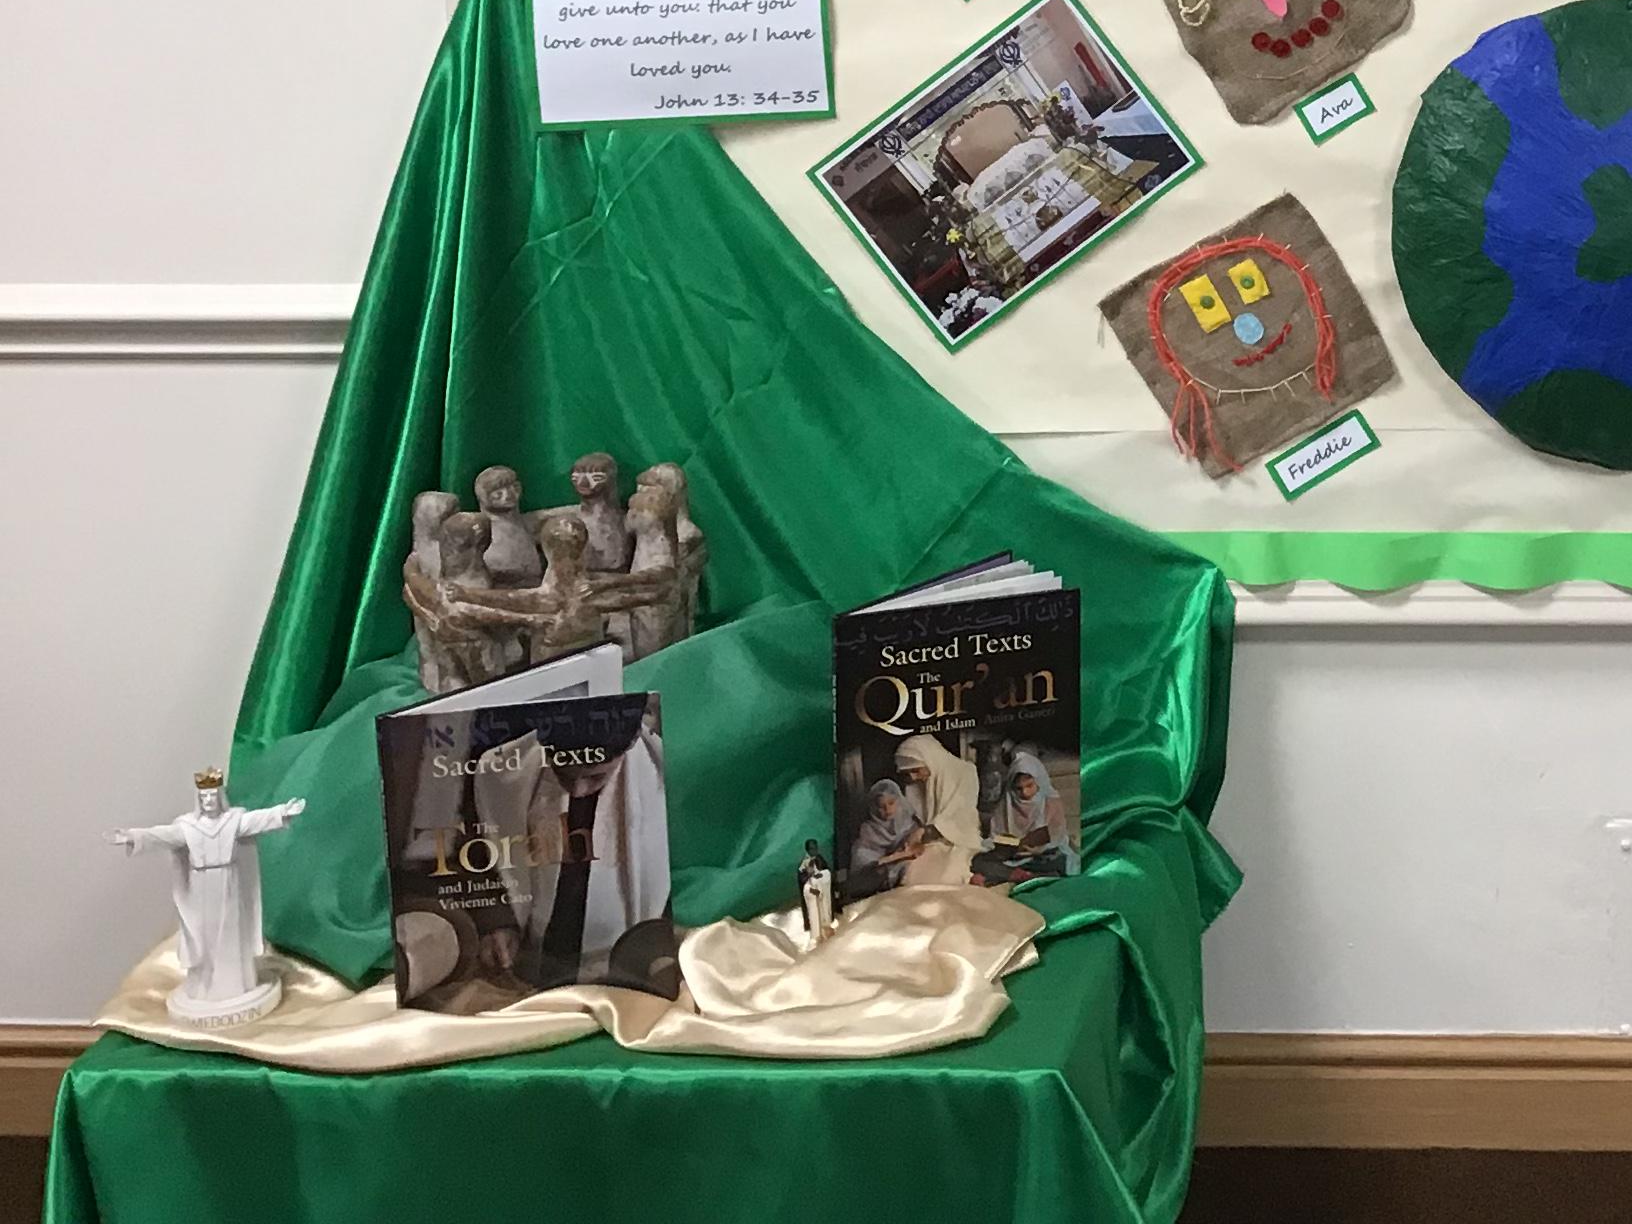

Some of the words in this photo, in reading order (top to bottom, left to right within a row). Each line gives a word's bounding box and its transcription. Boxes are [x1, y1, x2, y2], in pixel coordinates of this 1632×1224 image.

[558, 4, 600, 21] give
[606, 1, 654, 16] unto
[659, 2, 700, 19] you:
[543, 35, 586, 49] love
[590, 36, 628, 48] one
[632, 31, 718, 47] another,
[725, 32, 748, 43] as
[752, 28, 758, 42] I
[766, 27, 816, 42] have
[630, 62, 686, 77] loved
[691, 63, 732, 78] you.
[655, 94, 708, 109] John
[713, 93, 746, 107] 13:
[753, 90, 820, 106] 34-35
[1321, 98, 1353, 124] Ava
[1287, 436, 1352, 480] Freddie
[880, 637, 960, 668] Sacred
[968, 631, 1033, 657] Texts
[916, 671, 941, 685] The
[919, 720, 941, 734] and
[945, 717, 976, 731] Islam
[433, 747, 522, 780] Sacred
[538, 743, 606, 769] Texts
[438, 880, 462, 894] and
[438, 897, 496, 911] Vivienne
